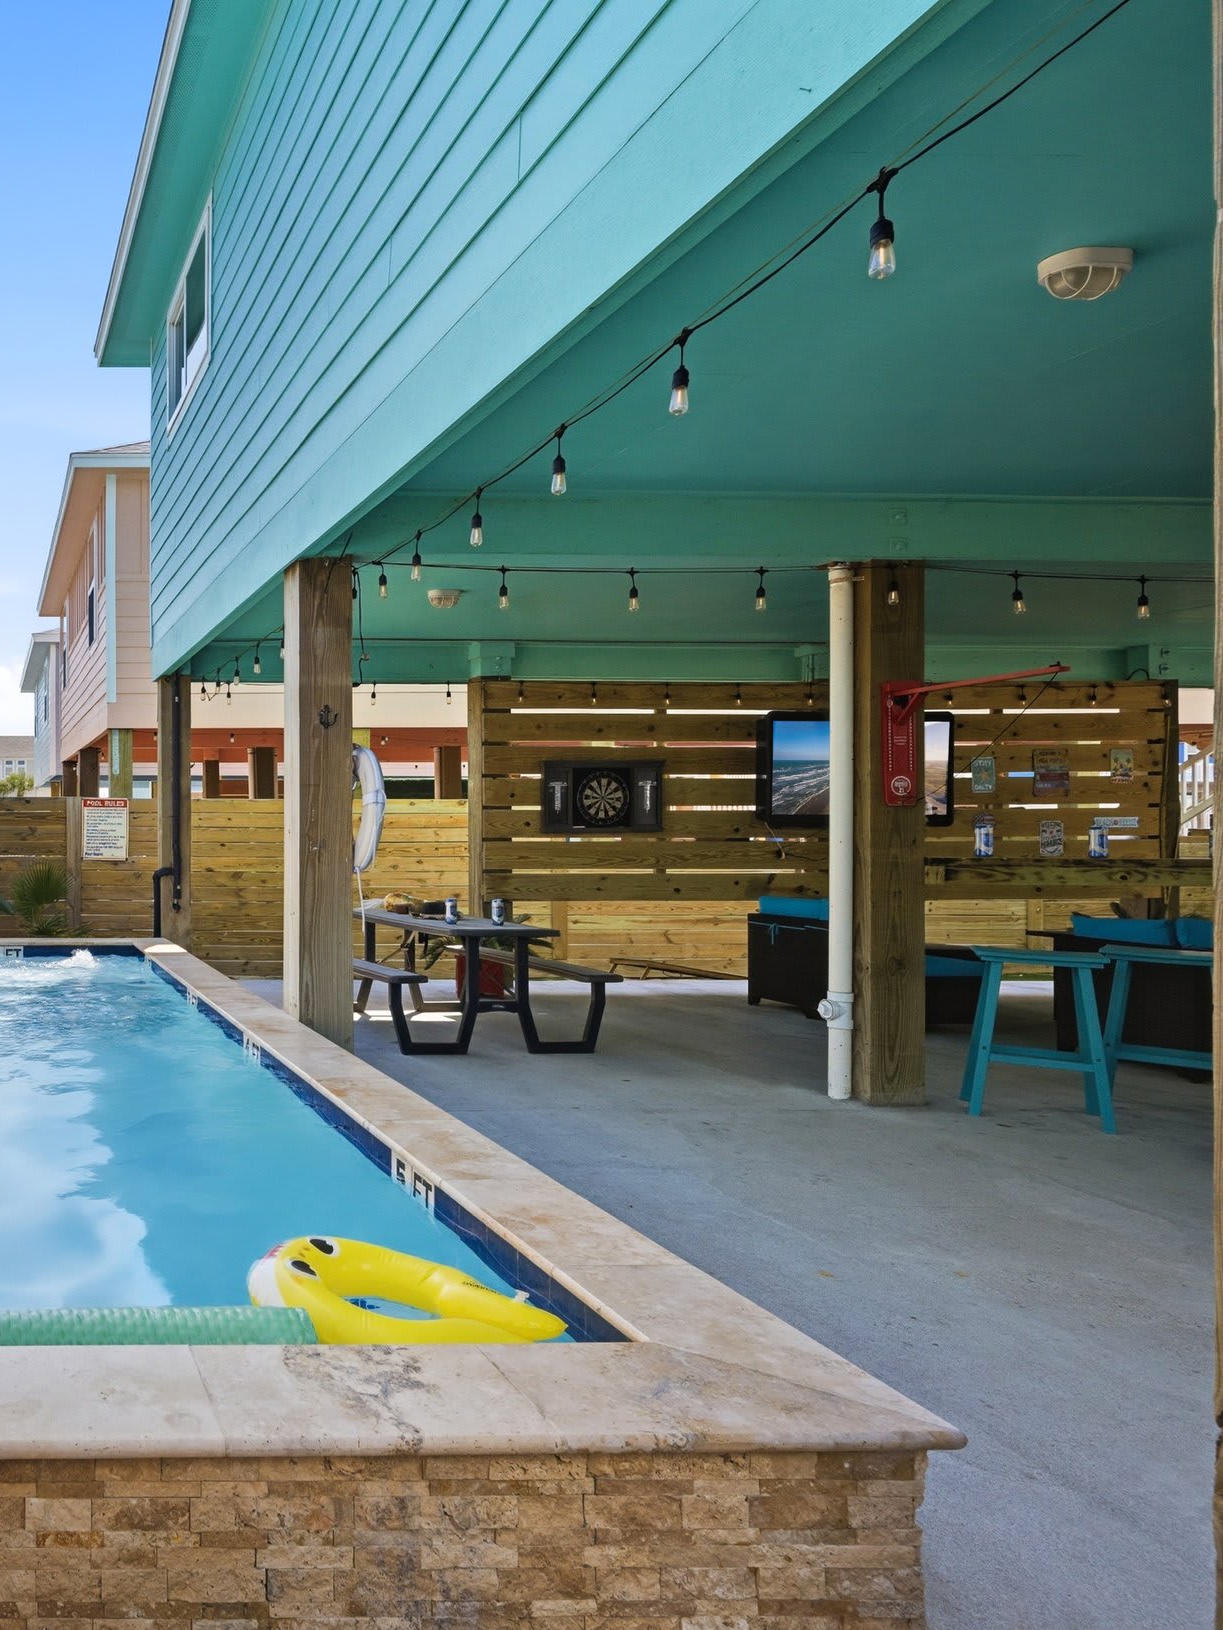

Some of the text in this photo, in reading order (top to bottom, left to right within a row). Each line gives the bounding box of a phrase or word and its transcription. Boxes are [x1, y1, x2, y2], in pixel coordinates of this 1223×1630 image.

[5, 948, 22, 958] FT
[396, 1158, 432, 1209] 5 FT
